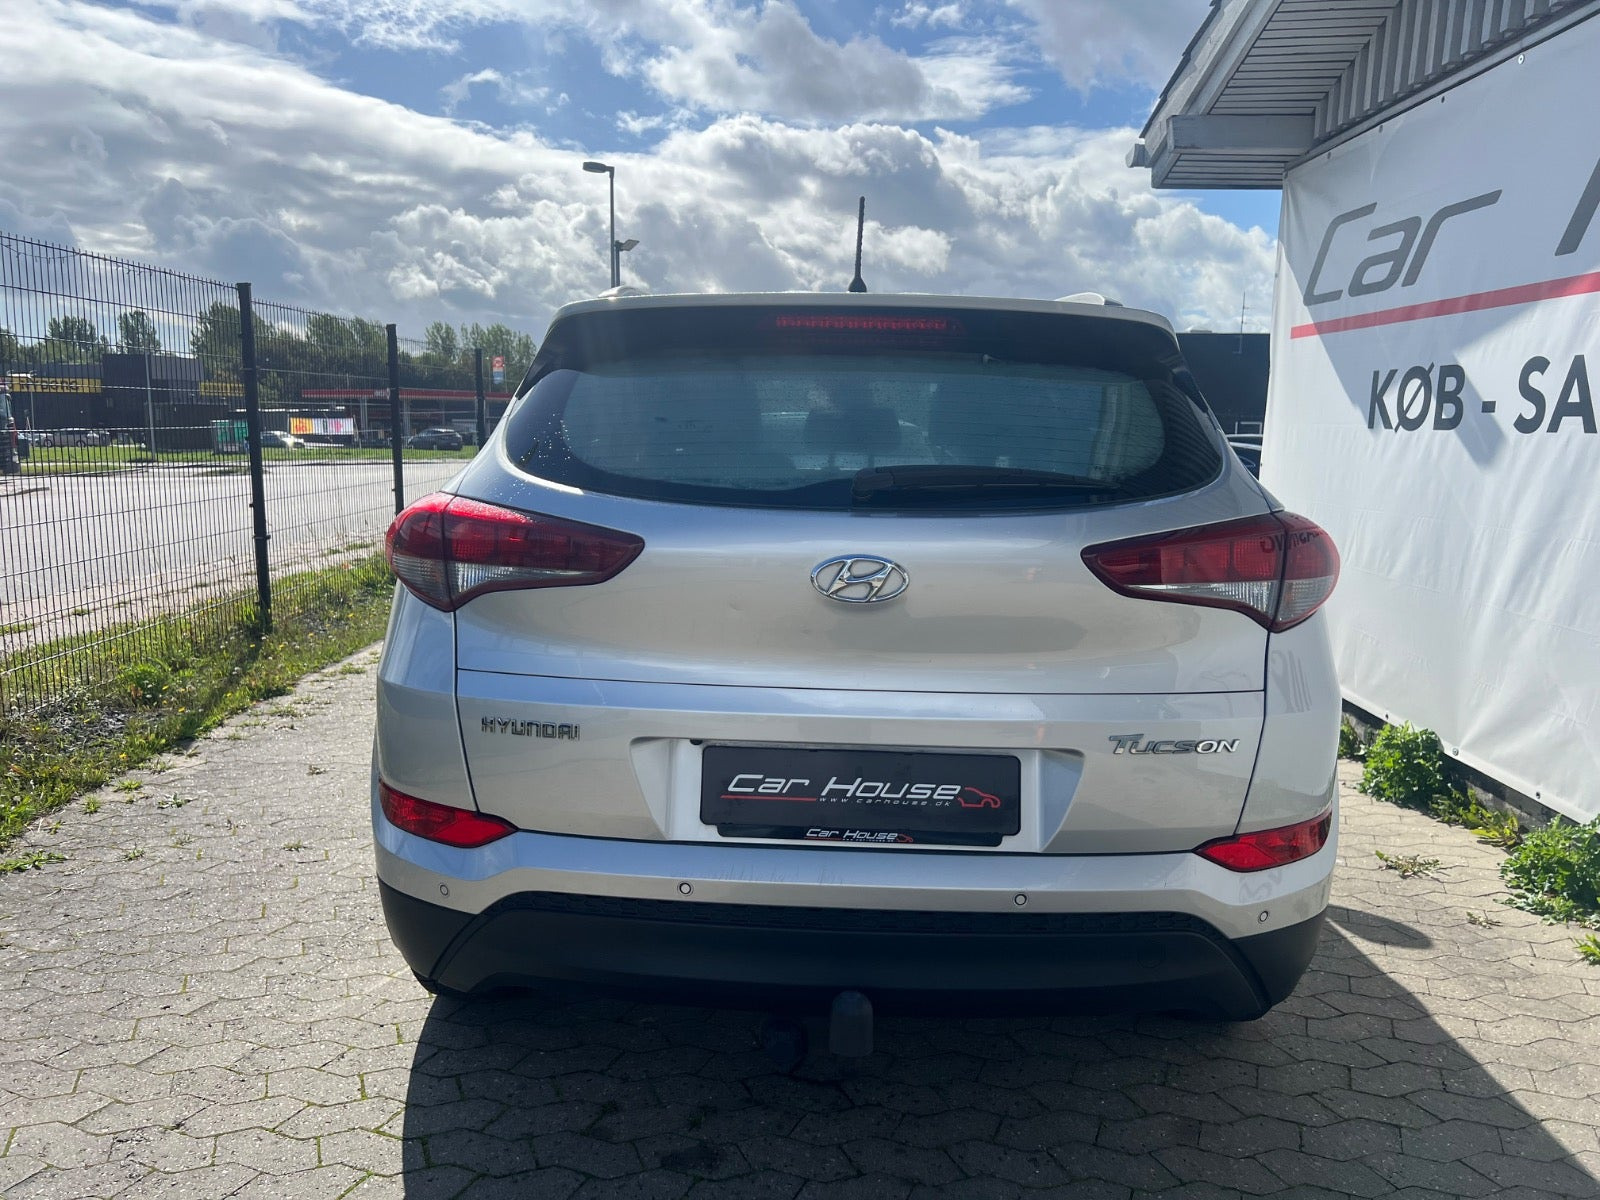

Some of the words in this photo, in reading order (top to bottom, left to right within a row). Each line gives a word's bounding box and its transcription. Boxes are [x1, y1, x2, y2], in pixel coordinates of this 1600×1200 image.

[1303, 189, 1502, 306] Car
[1367, 362, 1466, 433] KØB
[481, 716, 580, 741] HYUNDAI
[727, 773, 810, 794] Car
[820, 776, 961, 800] House
[806, 828, 839, 838] Car
[842, 829, 898, 840] House
